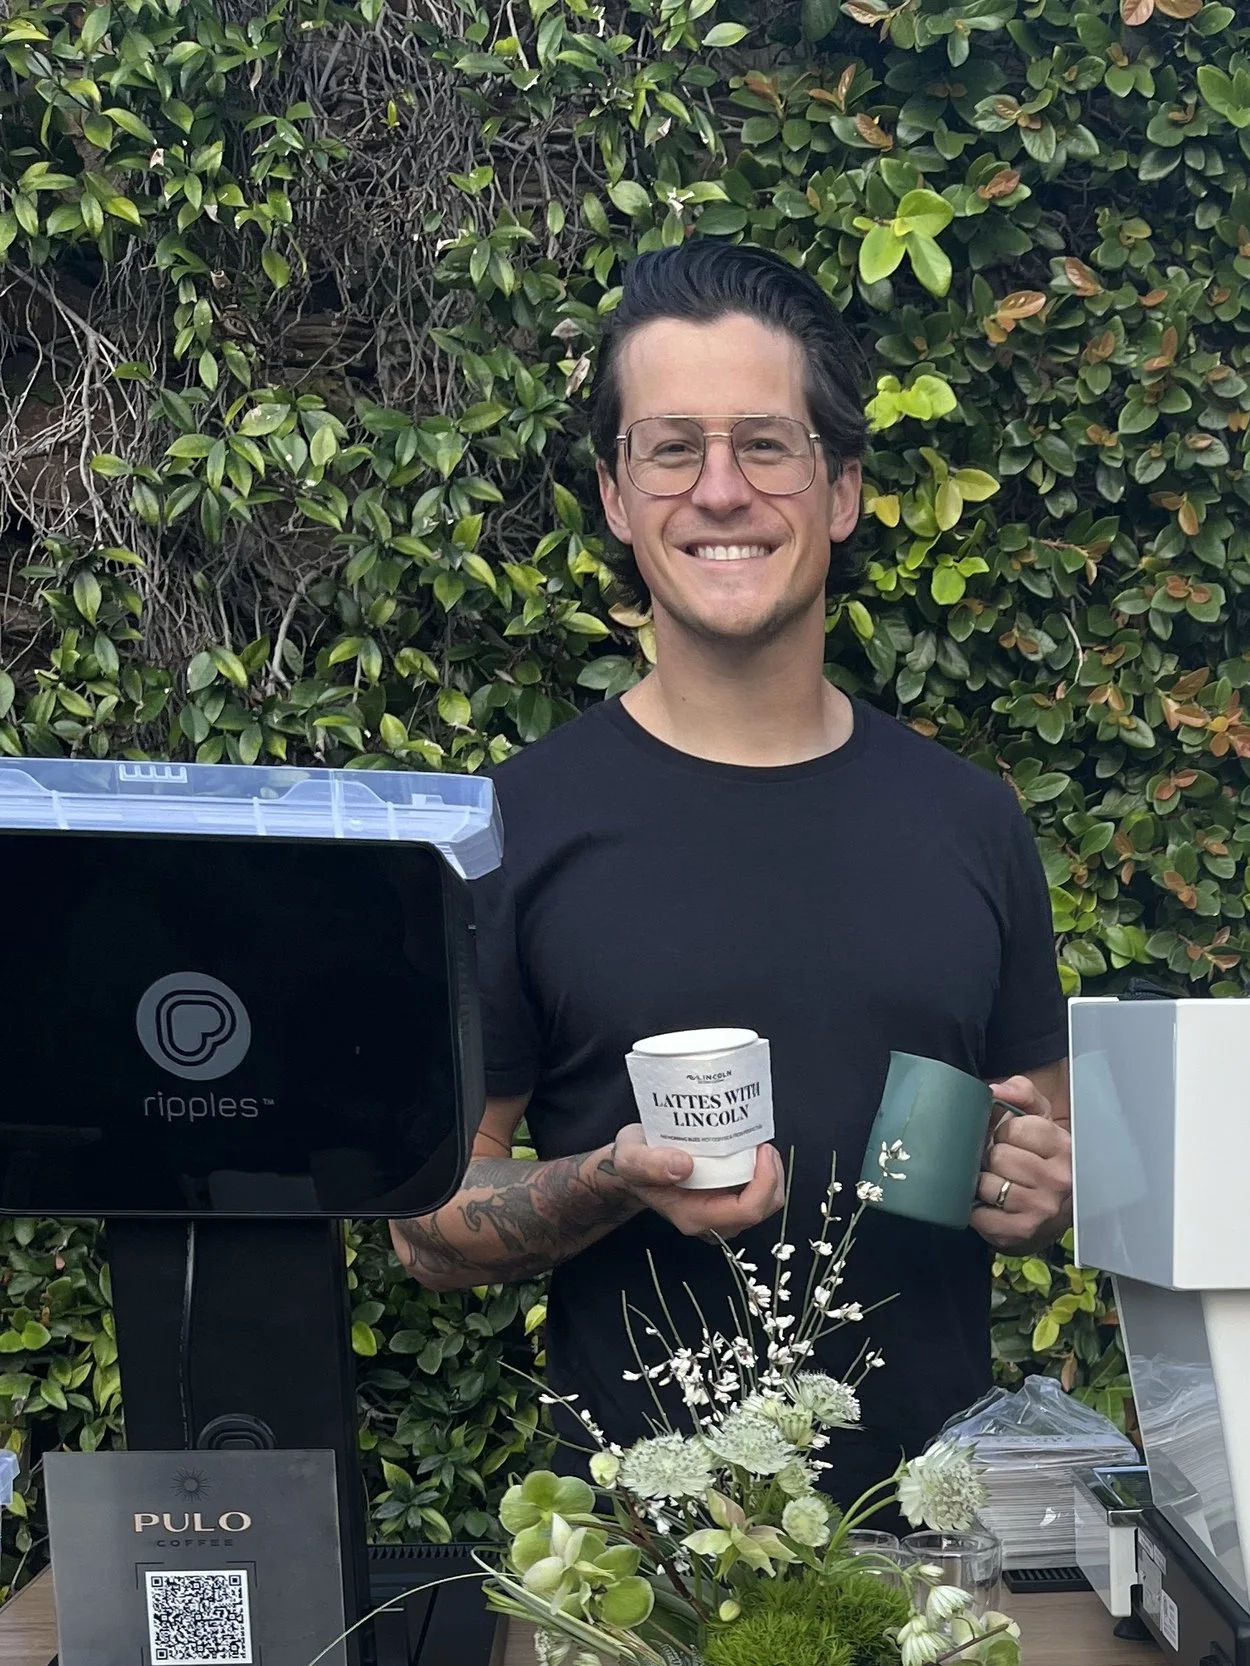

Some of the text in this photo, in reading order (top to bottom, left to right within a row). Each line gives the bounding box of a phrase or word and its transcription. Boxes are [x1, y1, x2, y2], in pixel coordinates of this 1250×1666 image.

[697, 1070, 732, 1081] LINCOLN
[652, 1081, 760, 1110] LATTES WITH
[673, 1104, 749, 1128] LINCOLN
[133, 1511, 252, 1533] PULO
[157, 1538, 234, 1547] COFFEE
